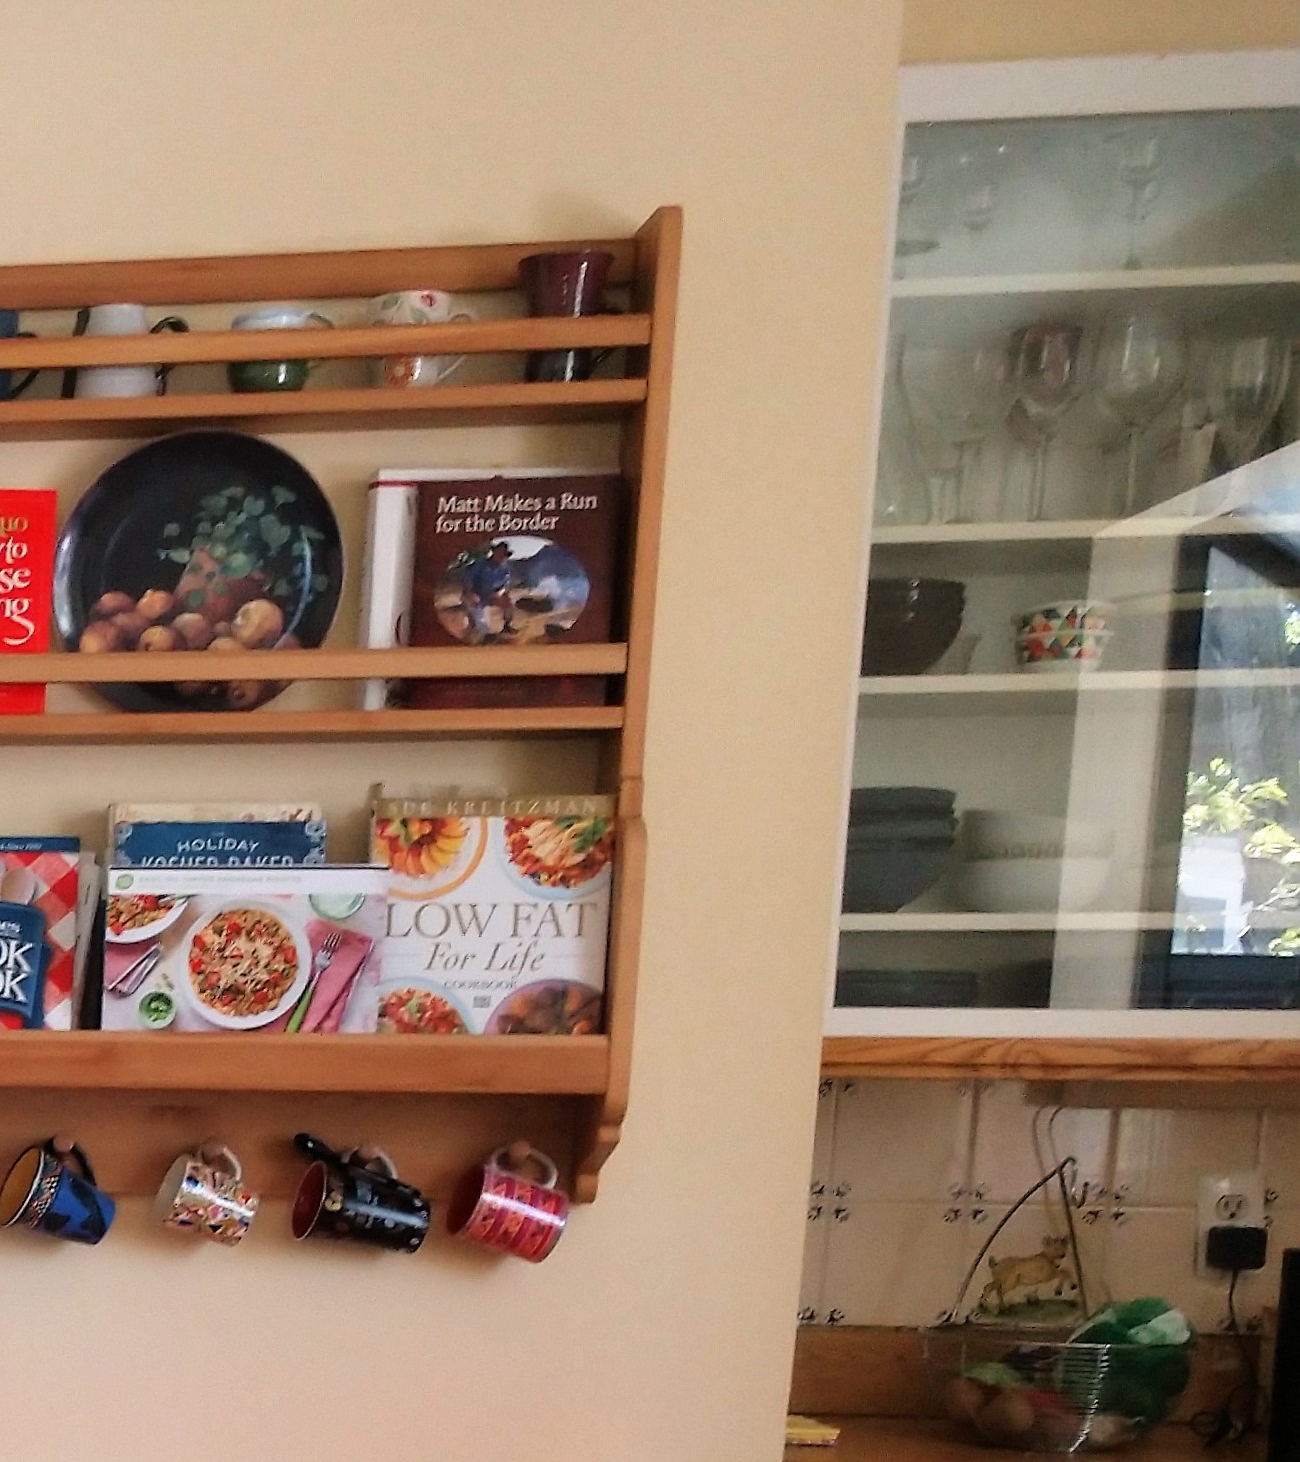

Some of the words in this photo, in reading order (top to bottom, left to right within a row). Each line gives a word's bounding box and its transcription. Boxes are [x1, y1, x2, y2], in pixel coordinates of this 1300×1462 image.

[437, 496, 481, 514] Matt
[484, 494, 542, 511] Makes
[544, 496, 556, 510] a
[559, 492, 599, 510] Run
[436, 515, 464, 534] for
[465, 514, 496, 532] the
[498, 511, 560, 531] Border
[5, 536, 28, 563] to
[177, 838, 260, 853] HOLIDAY
[385, 902, 497, 938] LOW
[511, 902, 597, 938] FAT
[425, 942, 476, 971] For
[484, 940, 546, 976] Life
